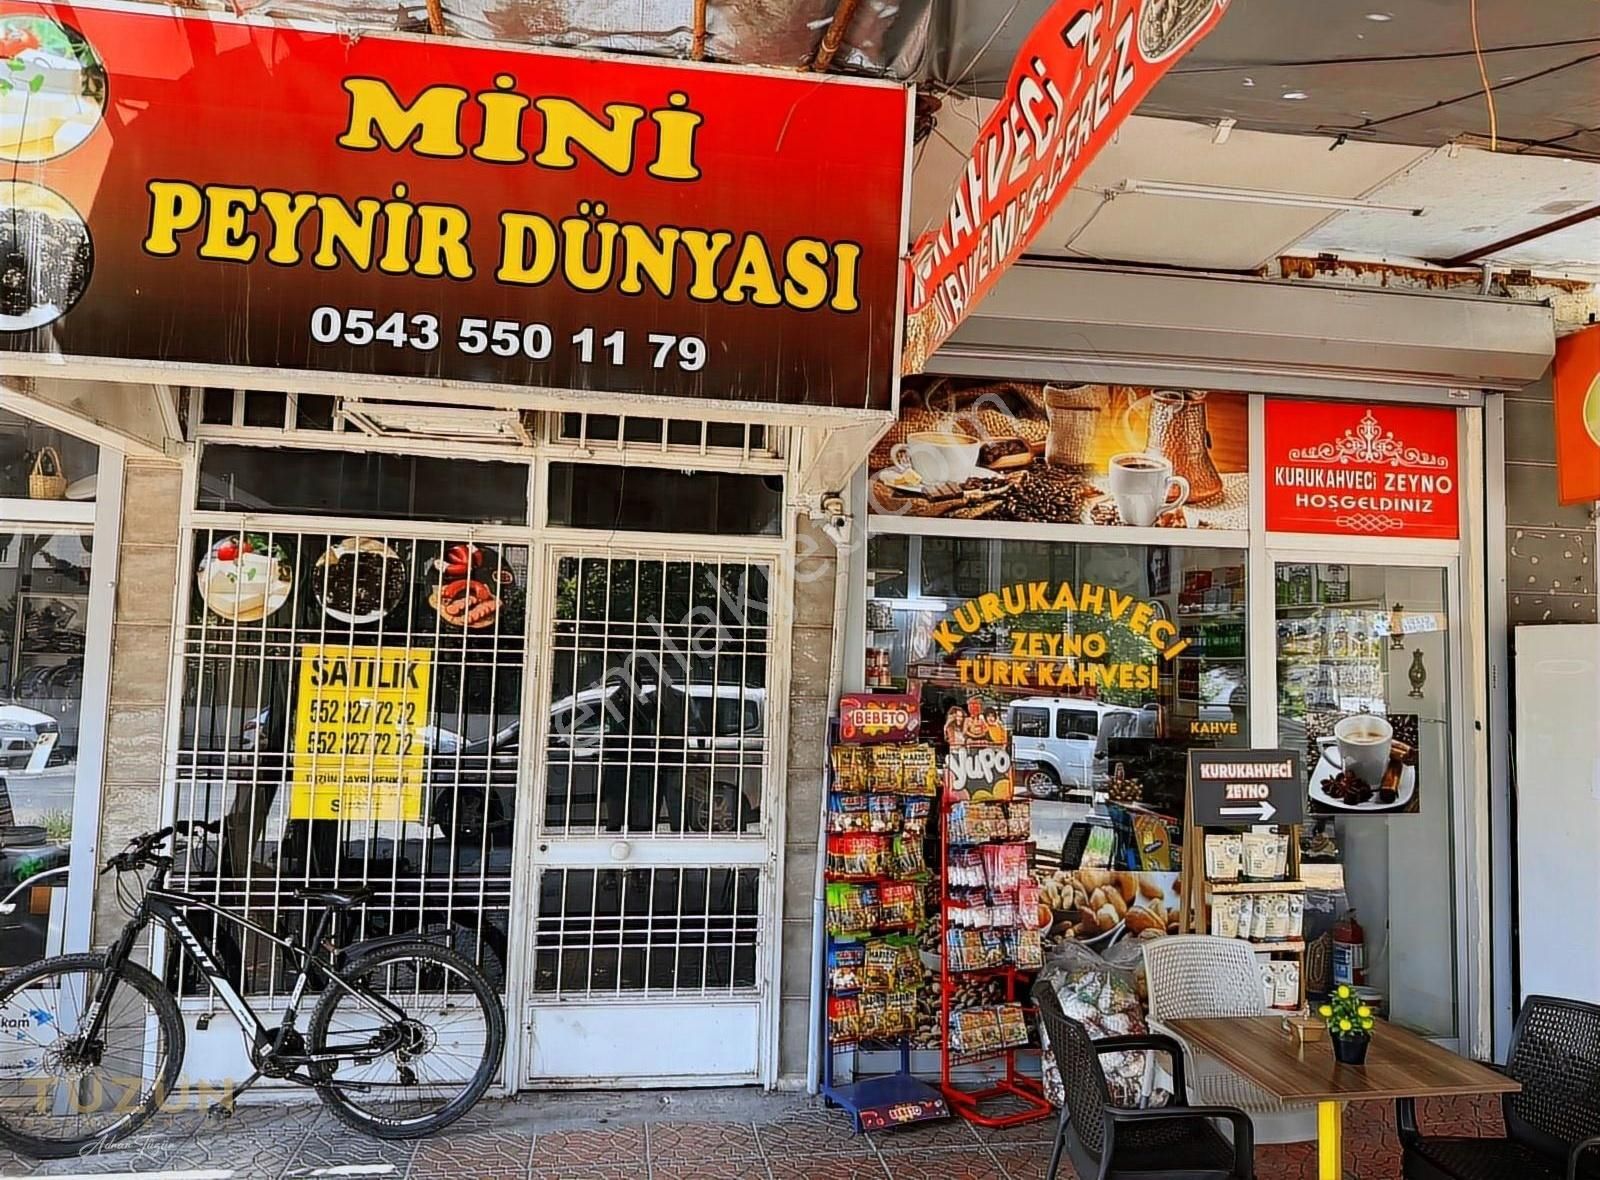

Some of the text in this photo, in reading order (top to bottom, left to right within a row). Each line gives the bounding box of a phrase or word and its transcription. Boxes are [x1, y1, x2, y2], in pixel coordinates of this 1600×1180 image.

[338, 75, 704, 181] MİNİ
[142, 182, 863, 312] PEYNİR DÜNYASI
[310, 306, 707, 371] 0543 550 11 79
[1384, 472, 1453, 494] ZEYNO
[1010, 632, 1109, 659] ZEYNO
[311, 655, 420, 688] SATILIK
[956, 654, 1029, 686] TÜRK
[310, 699, 339, 723] 552
[854, 709, 909, 726] BEBETO
[1190, 720, 1239, 735] KAHVE
[307, 731, 336, 754] 552
[1200, 759, 1294, 779] KURUKAHVECİ
[1225, 783, 1270, 799] ZEYNO
